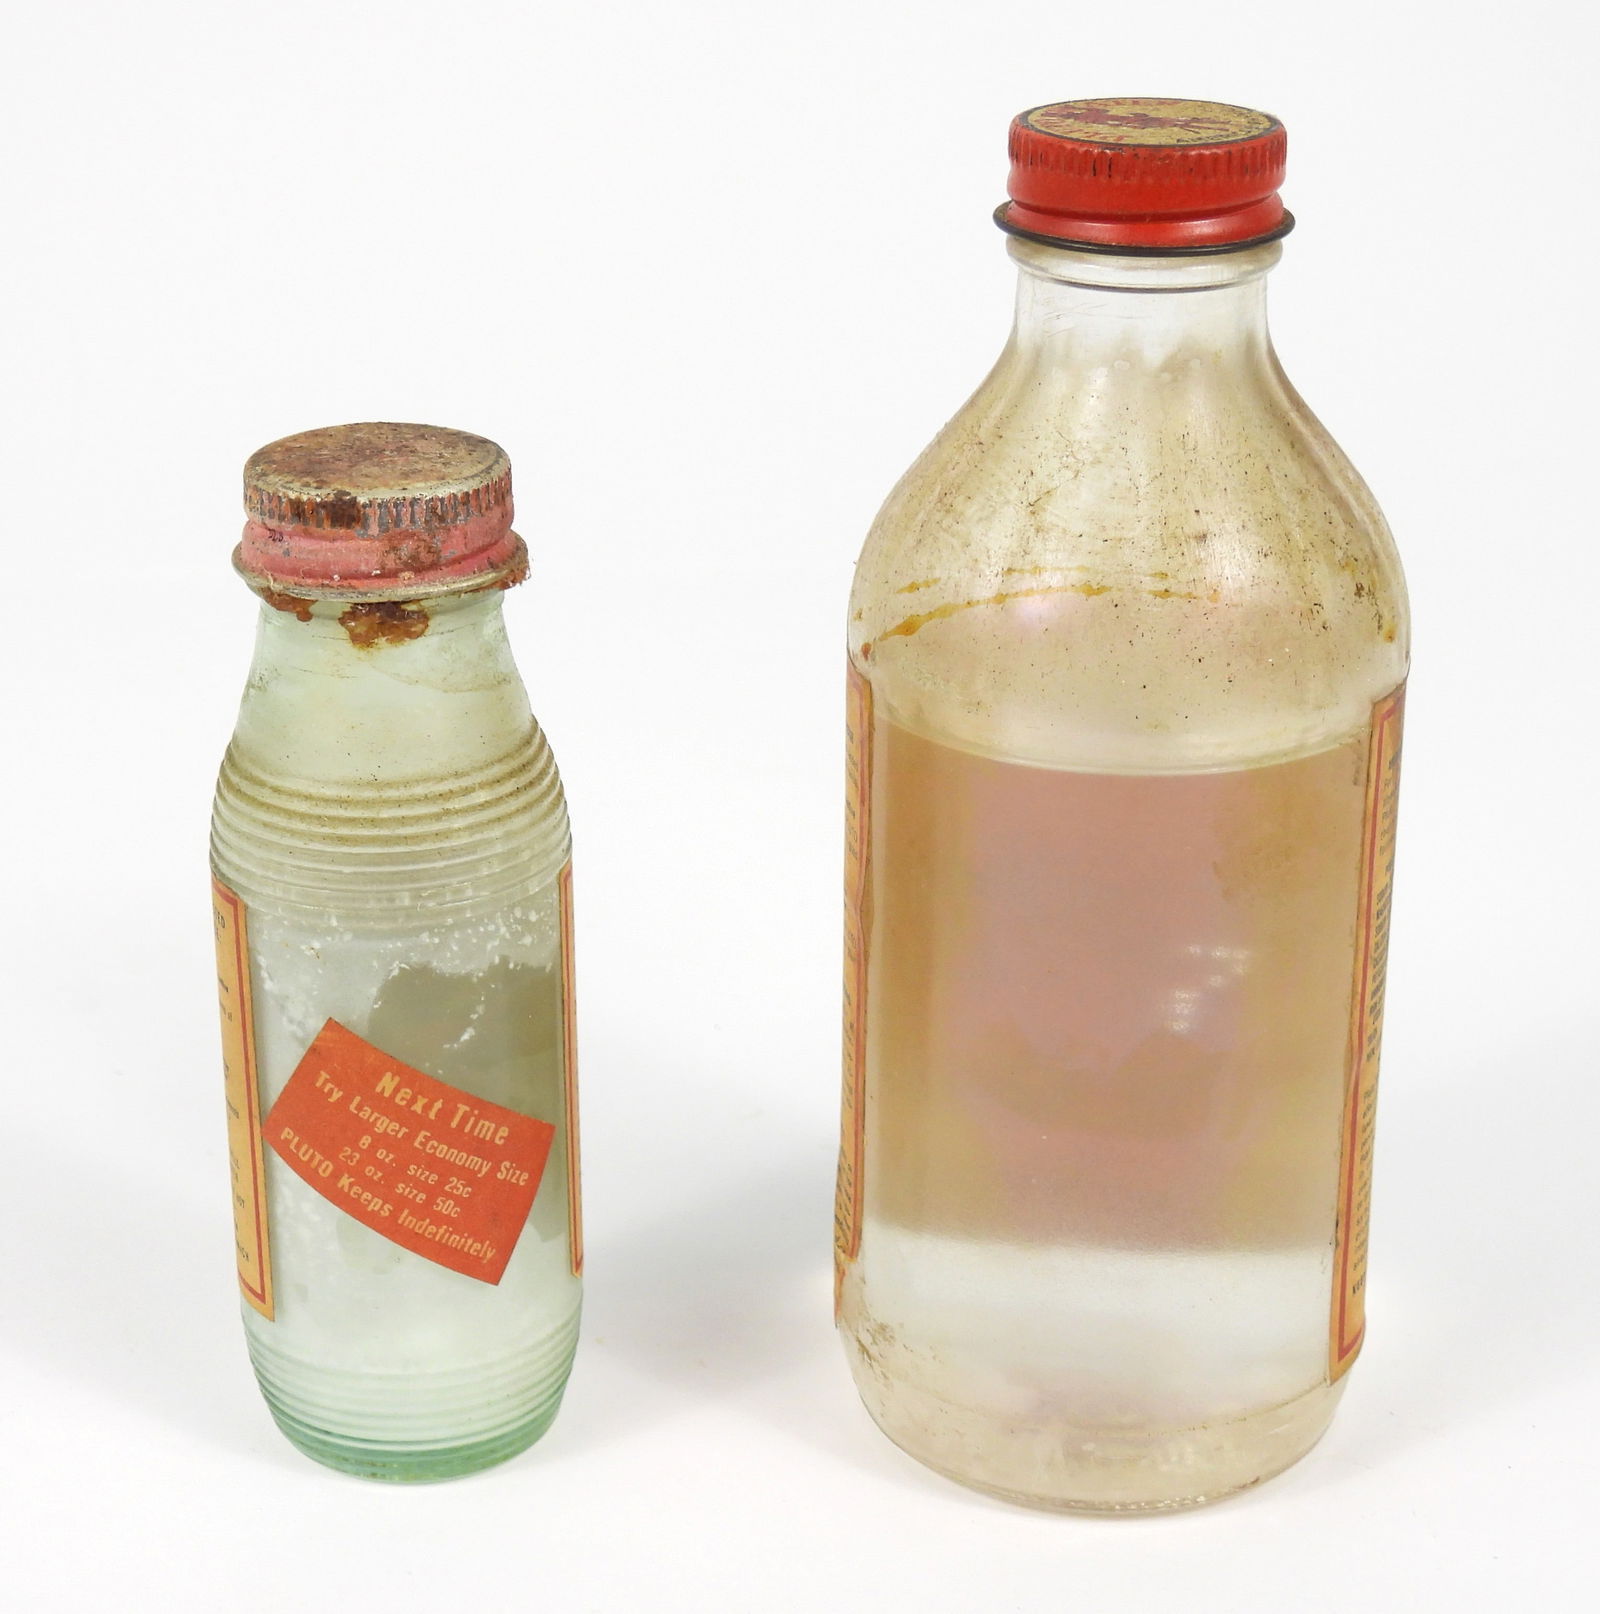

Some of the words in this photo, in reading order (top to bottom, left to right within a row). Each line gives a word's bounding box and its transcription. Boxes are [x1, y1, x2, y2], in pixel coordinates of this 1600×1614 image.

[314, 1070, 344, 1103] Try
[349, 1095, 409, 1139] Larger
[413, 1130, 492, 1178] Economy
[496, 1160, 529, 1186] Size
[374, 1071, 444, 1121] Next
[450, 1103, 509, 1146] Time
[280, 1126, 334, 1178] PLUTO
[337, 1173, 394, 1217] Keeps
[397, 1207, 497, 1264] Indefinitely
[338, 1146, 361, 1167] 23
[364, 1165, 385, 1185] oz.
[394, 1182, 427, 1204] size
[432, 1196, 461, 1218] 50c
[358, 1134, 372, 1150] 8
[376, 1148, 396, 1167] oz.
[406, 1164, 439, 1185] size
[443, 1176, 473, 1198] 25c
